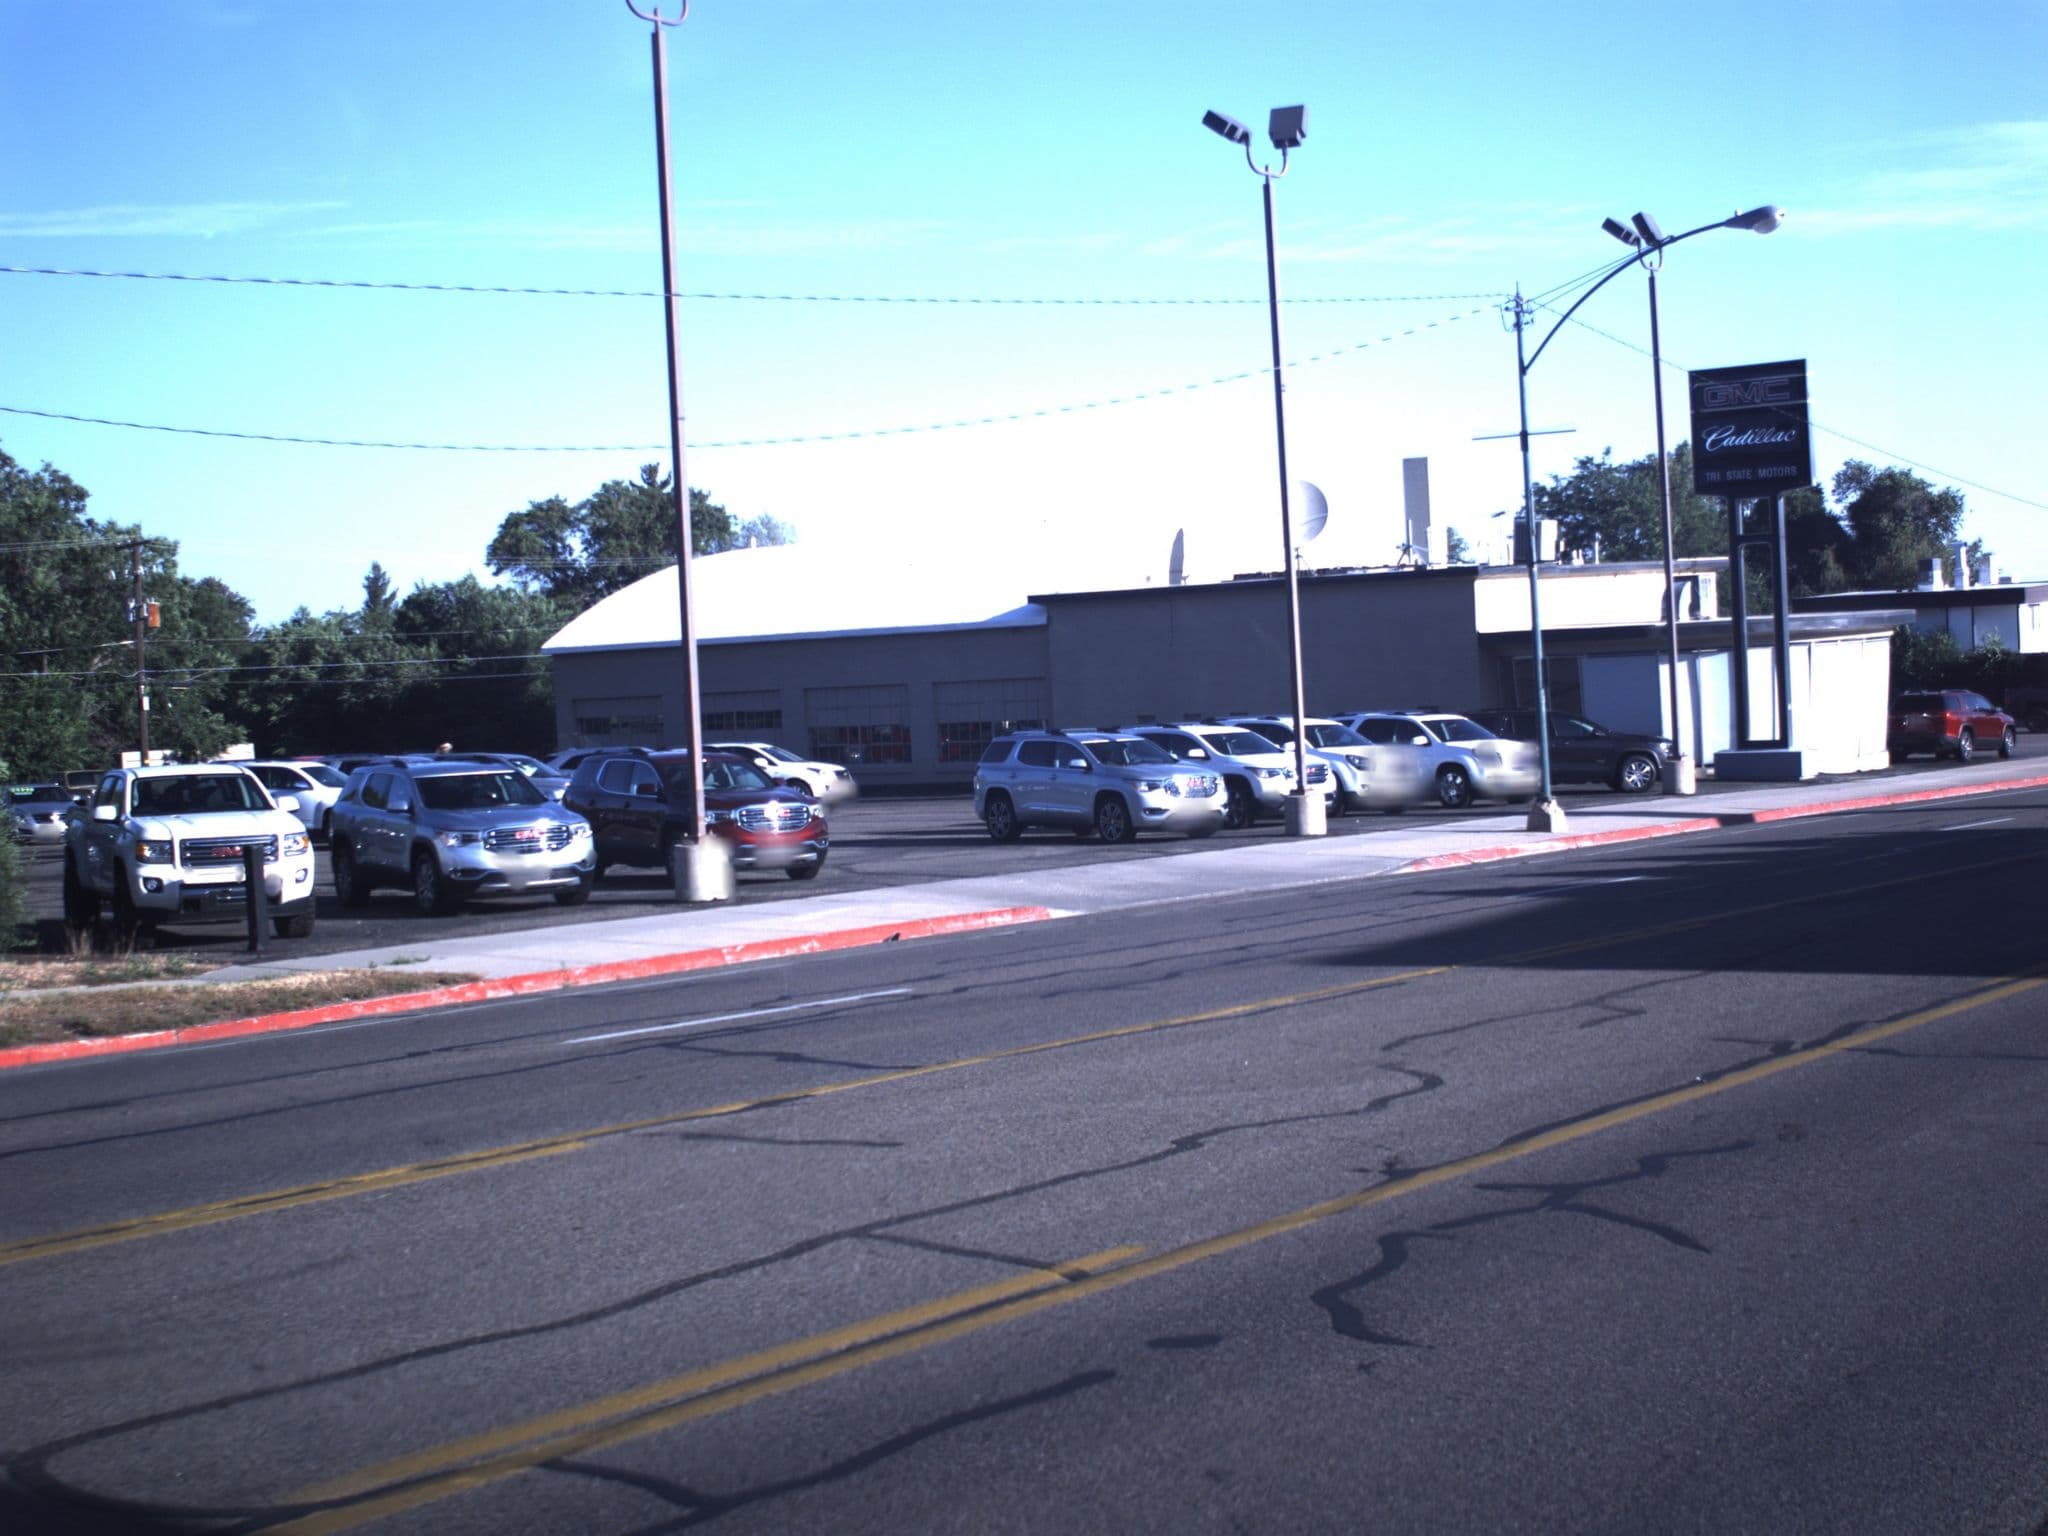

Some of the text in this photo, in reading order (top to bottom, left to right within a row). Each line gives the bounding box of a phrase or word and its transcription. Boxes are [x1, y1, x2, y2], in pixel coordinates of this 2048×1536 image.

[1704, 379, 1790, 407] GMC
[1703, 425, 1797, 452] Cadillac
[1727, 468, 1753, 480] STATE
[1758, 466, 1797, 479] MOTORS
